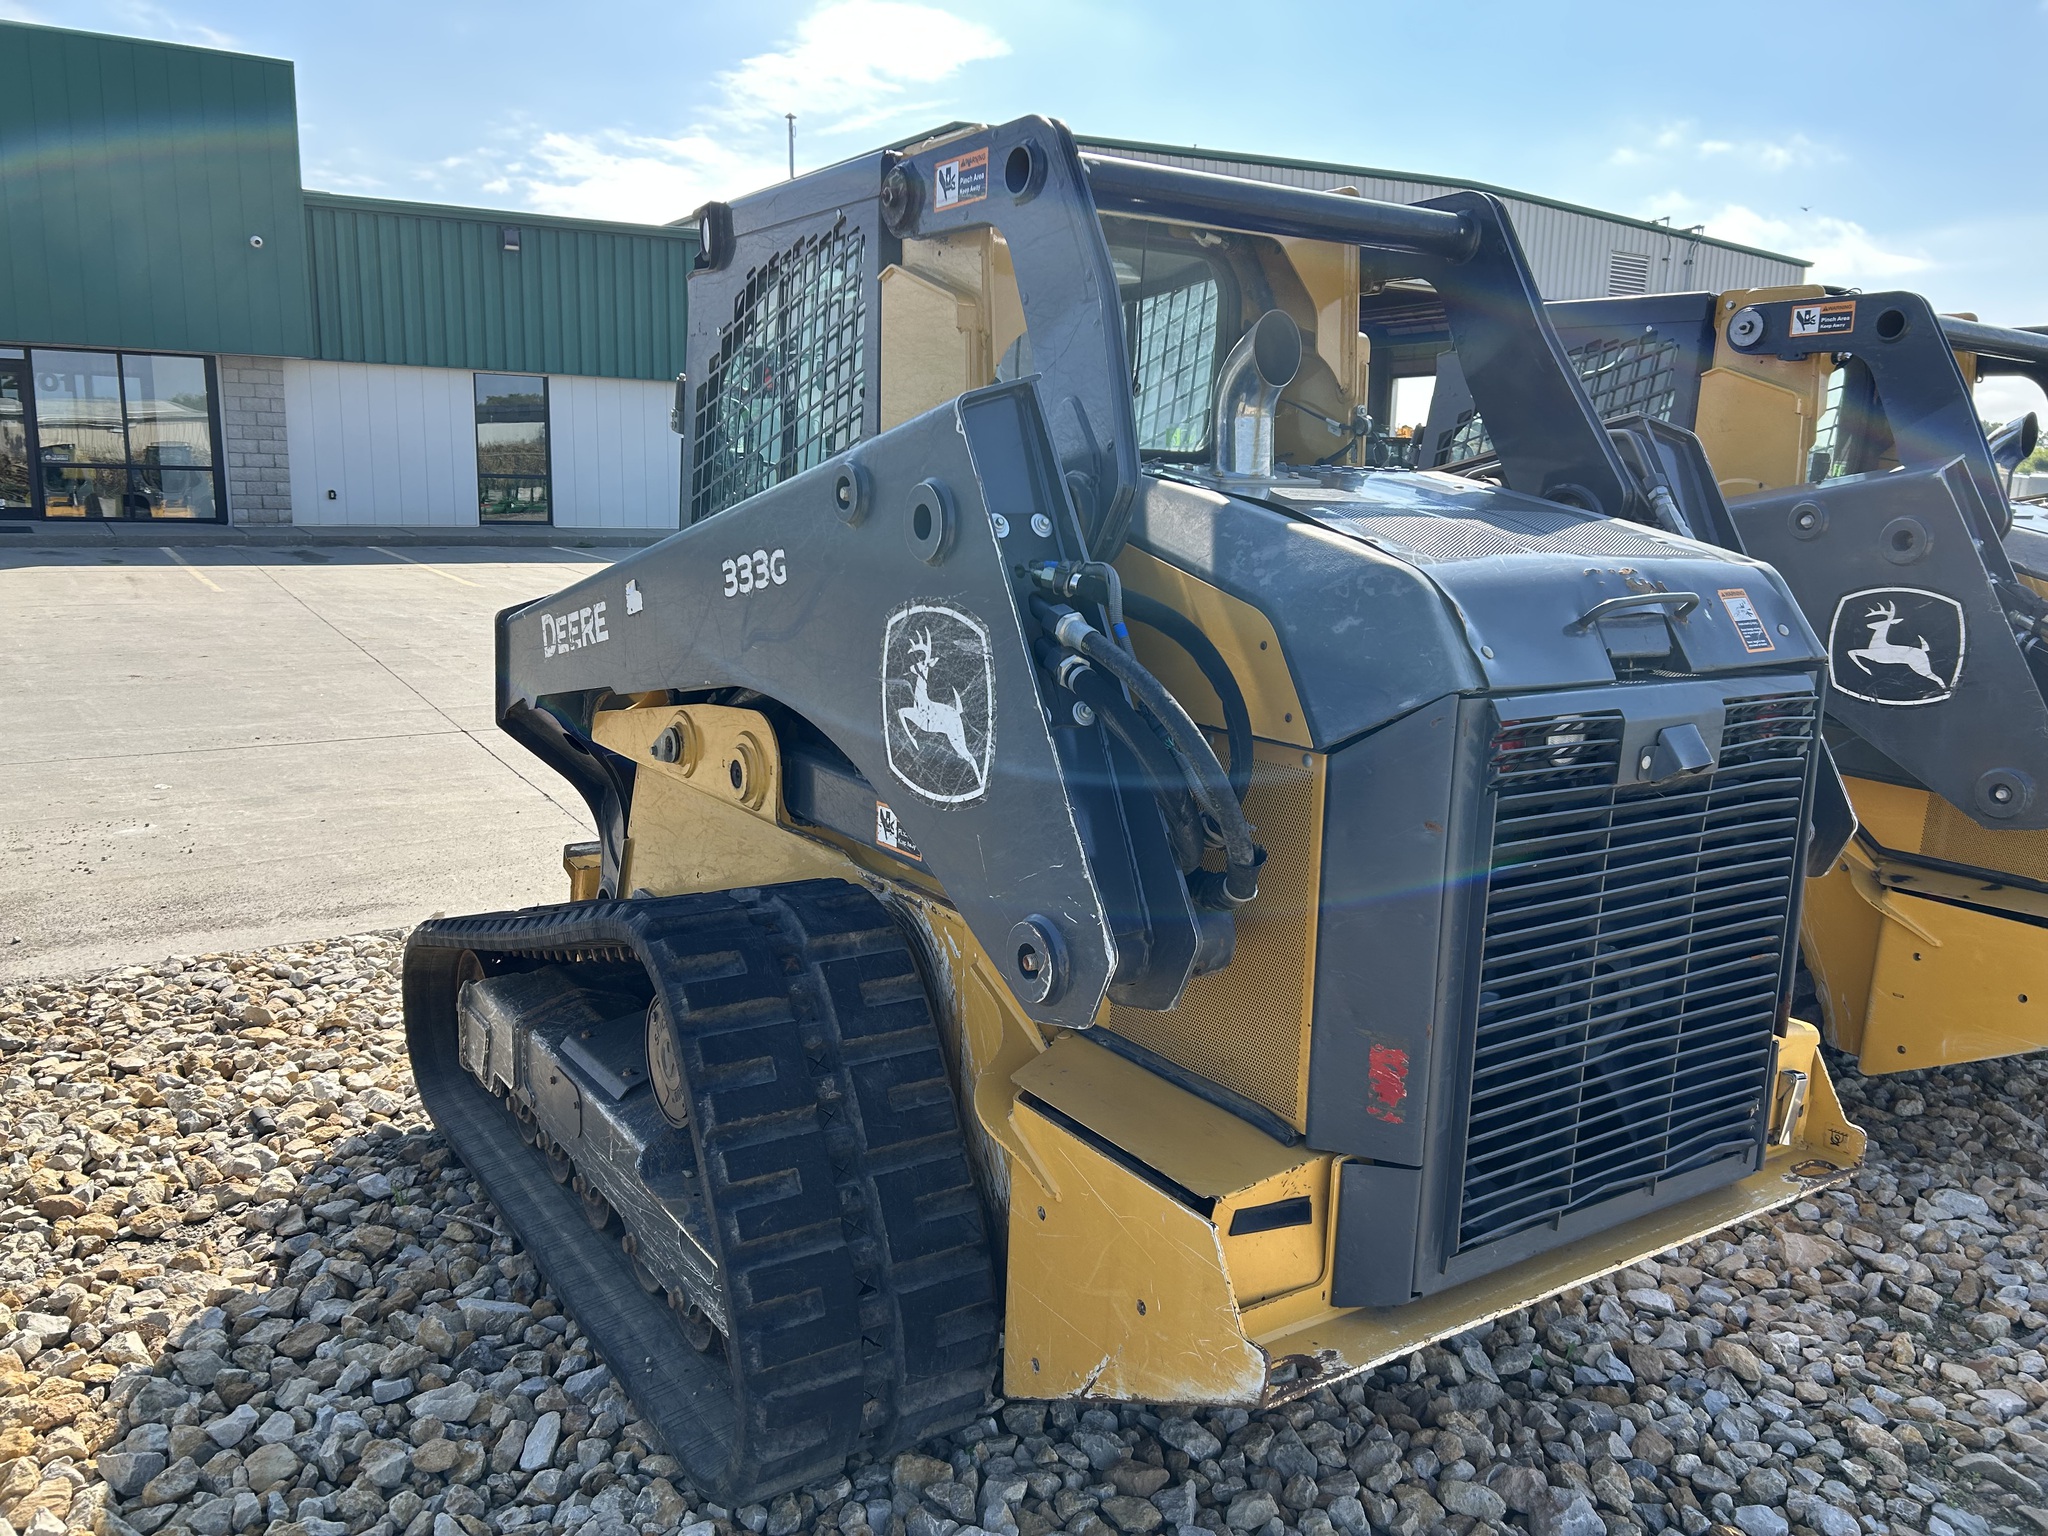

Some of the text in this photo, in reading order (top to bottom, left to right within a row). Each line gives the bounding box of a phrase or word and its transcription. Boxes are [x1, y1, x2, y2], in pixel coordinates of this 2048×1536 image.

[960, 172, 985, 185] Pinch Area
[970, 184, 981, 193] Away
[721, 548, 788, 598] 333G
[541, 601, 610, 659] DEERE
